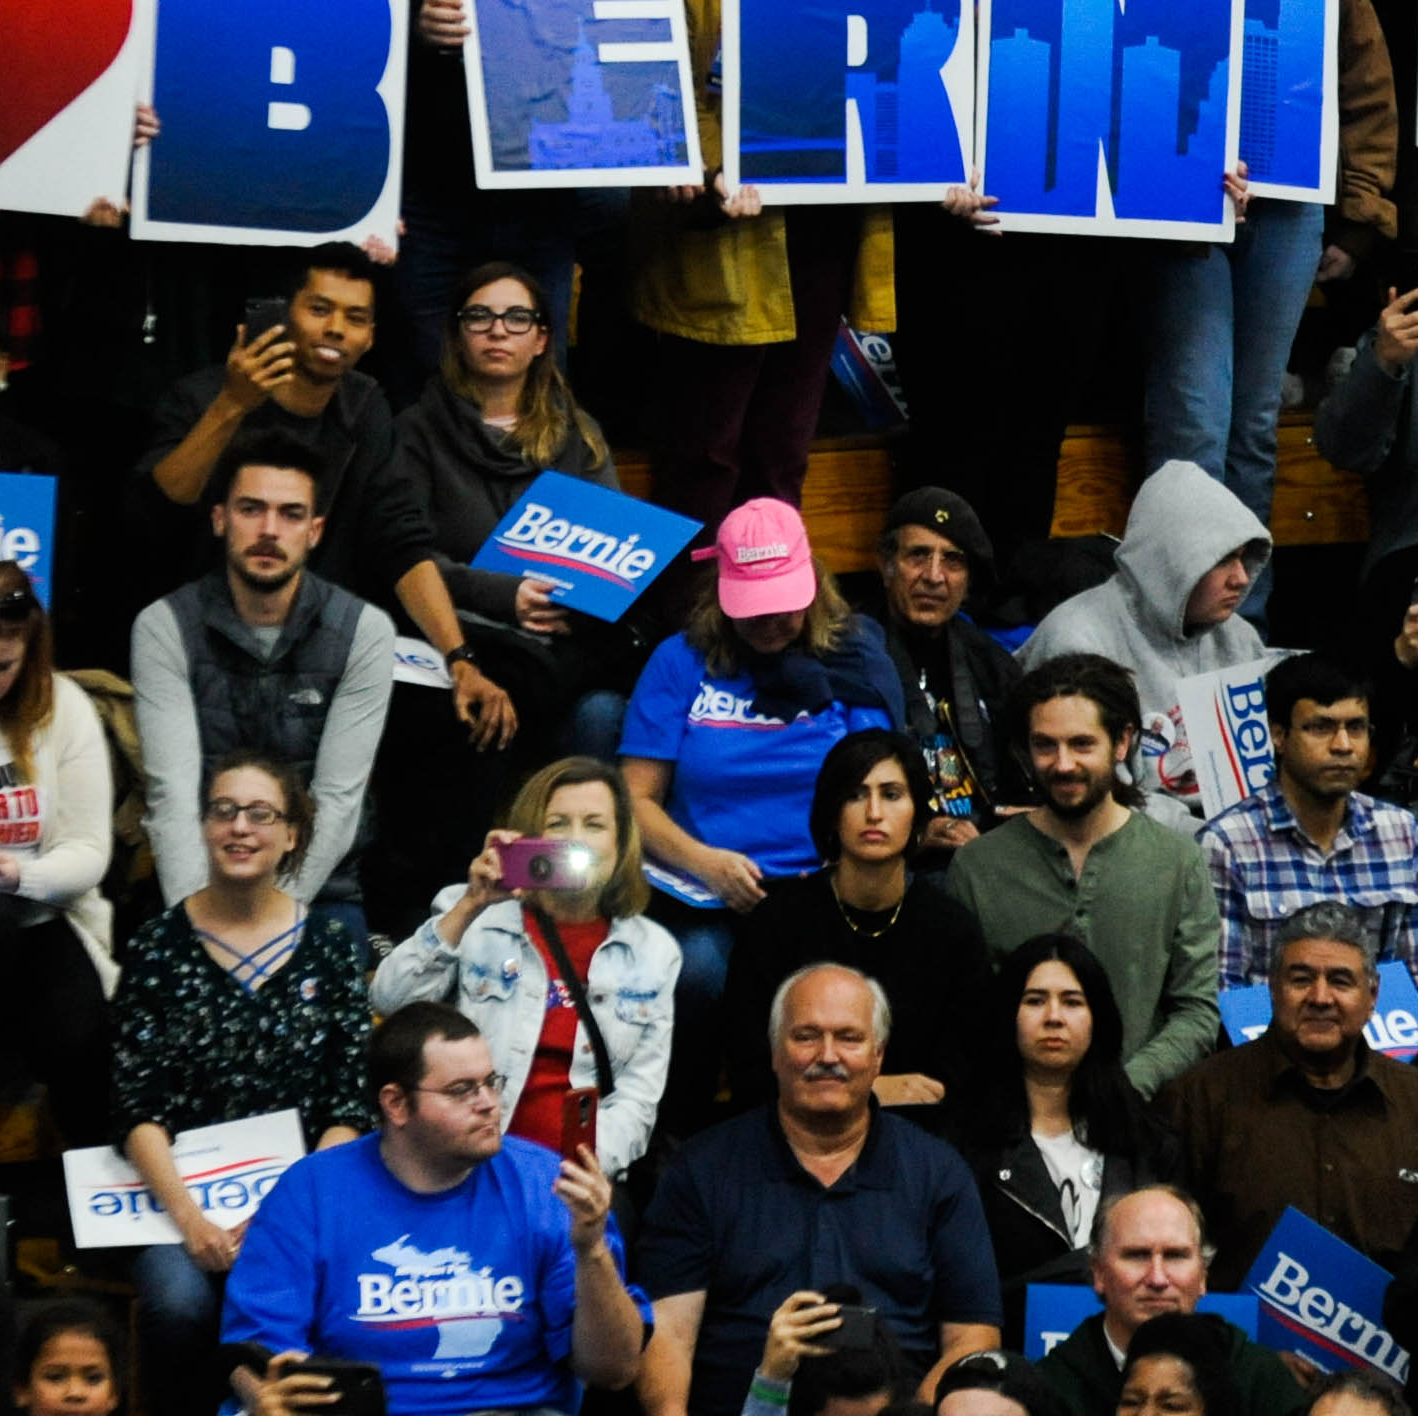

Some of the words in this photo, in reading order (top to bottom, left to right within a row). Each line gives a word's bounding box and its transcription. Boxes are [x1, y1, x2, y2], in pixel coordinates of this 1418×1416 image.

[503, 502, 657, 582] Bernie
[689, 680, 754, 716] Ber
[1225, 674, 1274, 800] Ber
[13, 787, 40, 817] TO
[355, 1267, 526, 1317] Bernie
[1266, 1252, 1418, 1388] Berni
